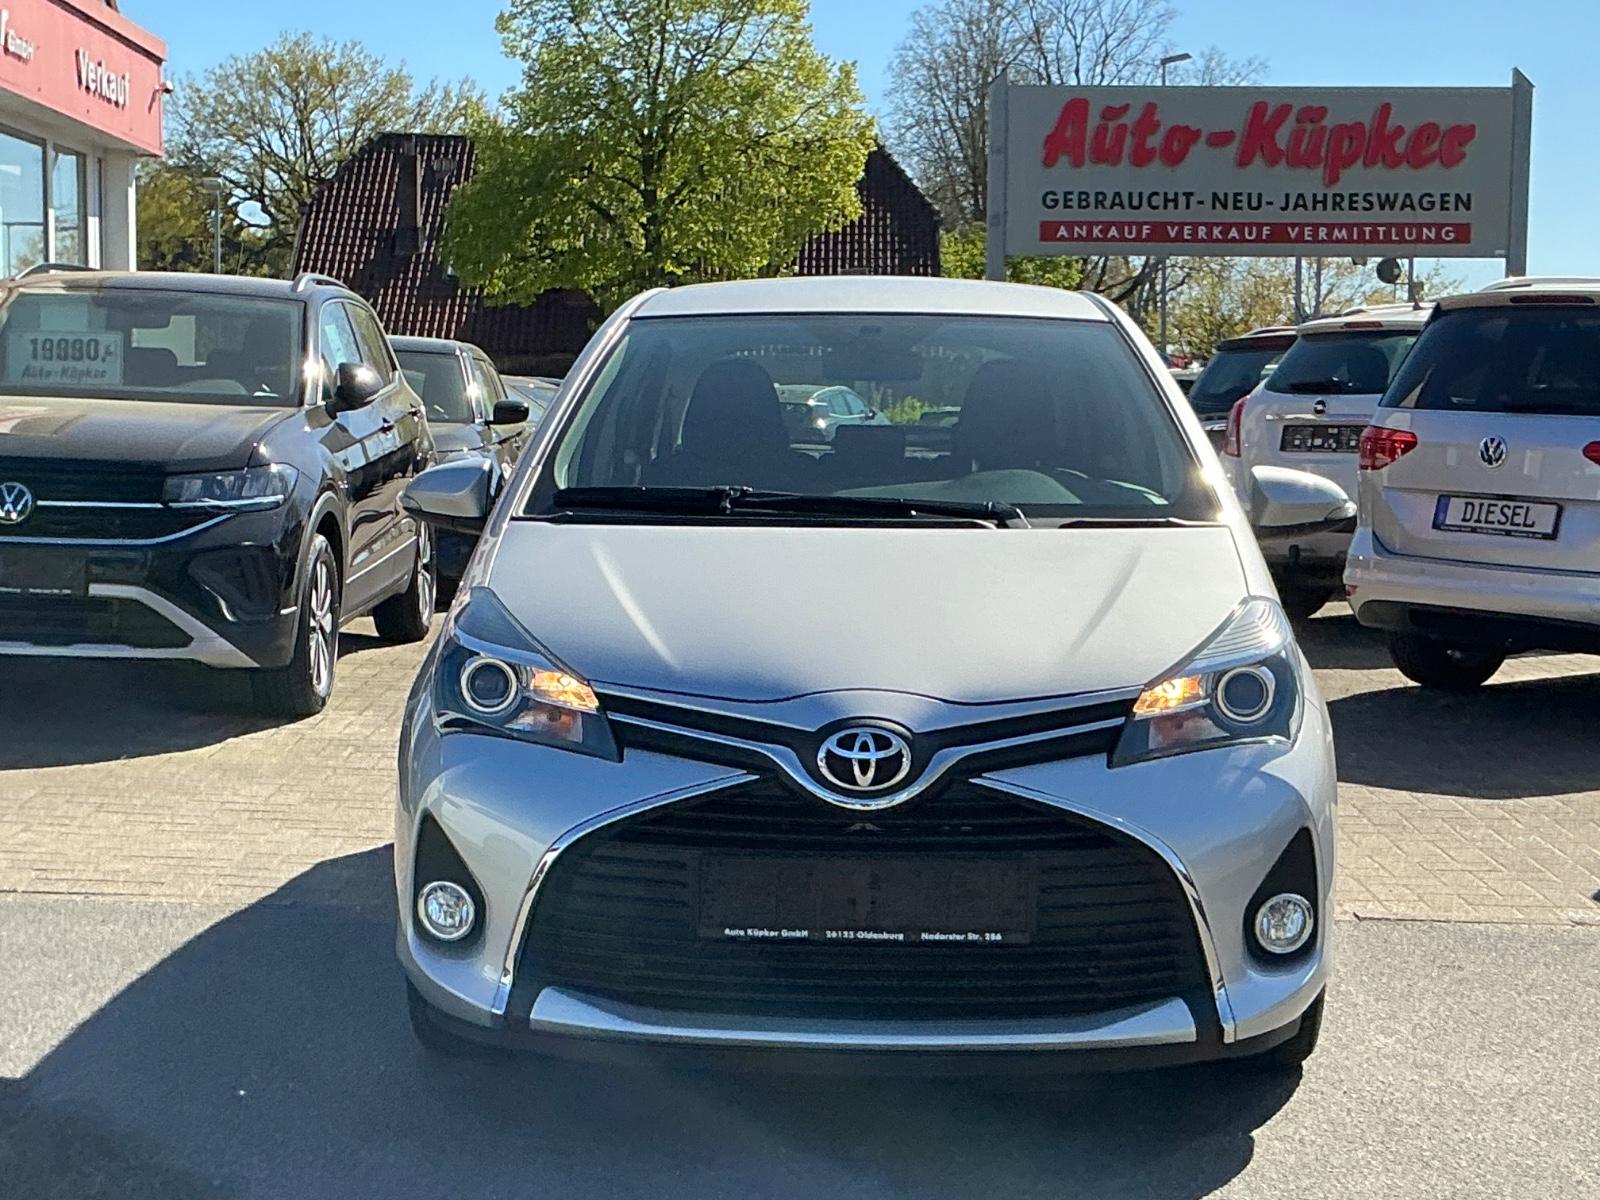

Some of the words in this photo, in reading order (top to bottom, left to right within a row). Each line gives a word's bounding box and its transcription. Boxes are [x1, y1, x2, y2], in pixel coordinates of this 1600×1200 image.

[78, 48, 130, 106] Verkauf
[1056, 224, 1151, 239] ANKAUF
[1167, 225, 1272, 240] VERKAUF
[1287, 226, 1456, 241] VERMITTLUNG
[1461, 501, 1536, 528] DIESEL
[856, 930, 904, 940] Oldenburg
